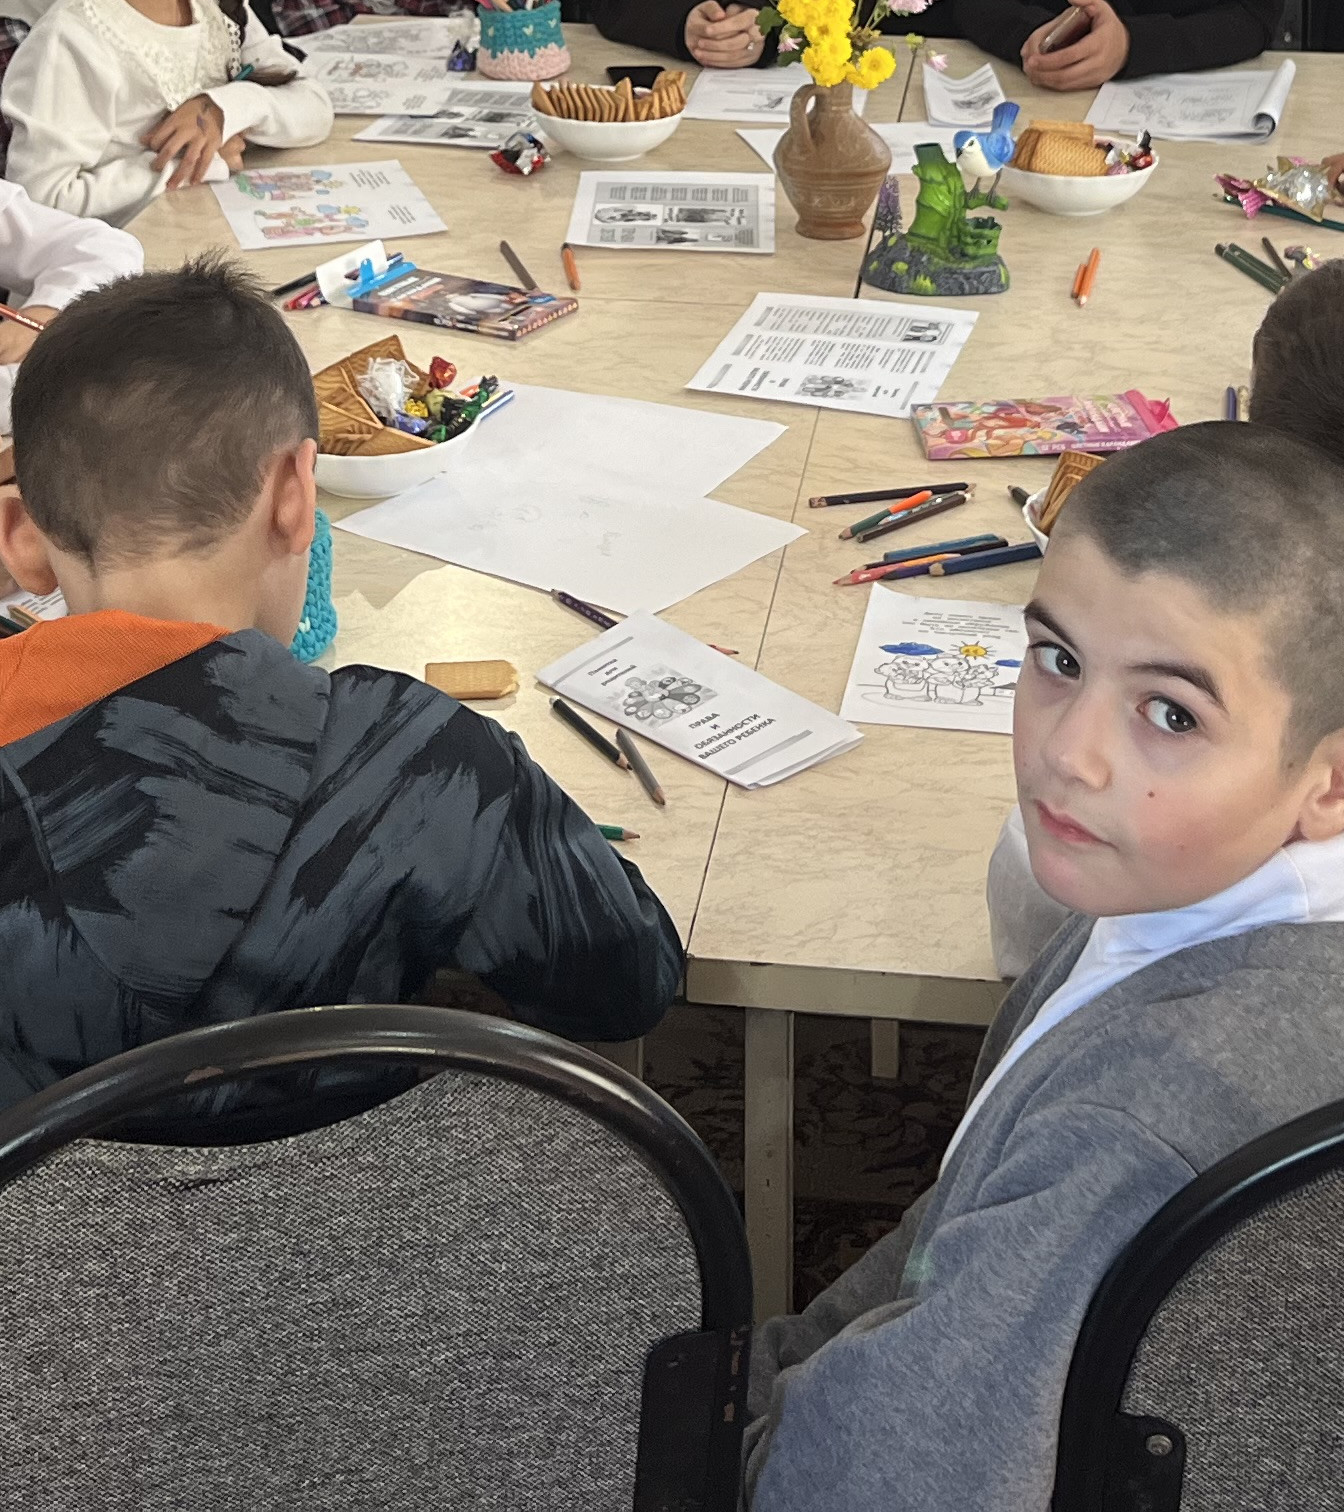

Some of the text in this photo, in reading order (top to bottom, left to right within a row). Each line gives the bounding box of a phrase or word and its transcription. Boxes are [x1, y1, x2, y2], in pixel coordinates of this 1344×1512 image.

[688, 711, 721, 731] ПРАВА
[694, 713, 761, 751] ОБЯЗАННОСТИ
[710, 723, 721, 731] И
[698, 736, 737, 760] ВАШЕГО
